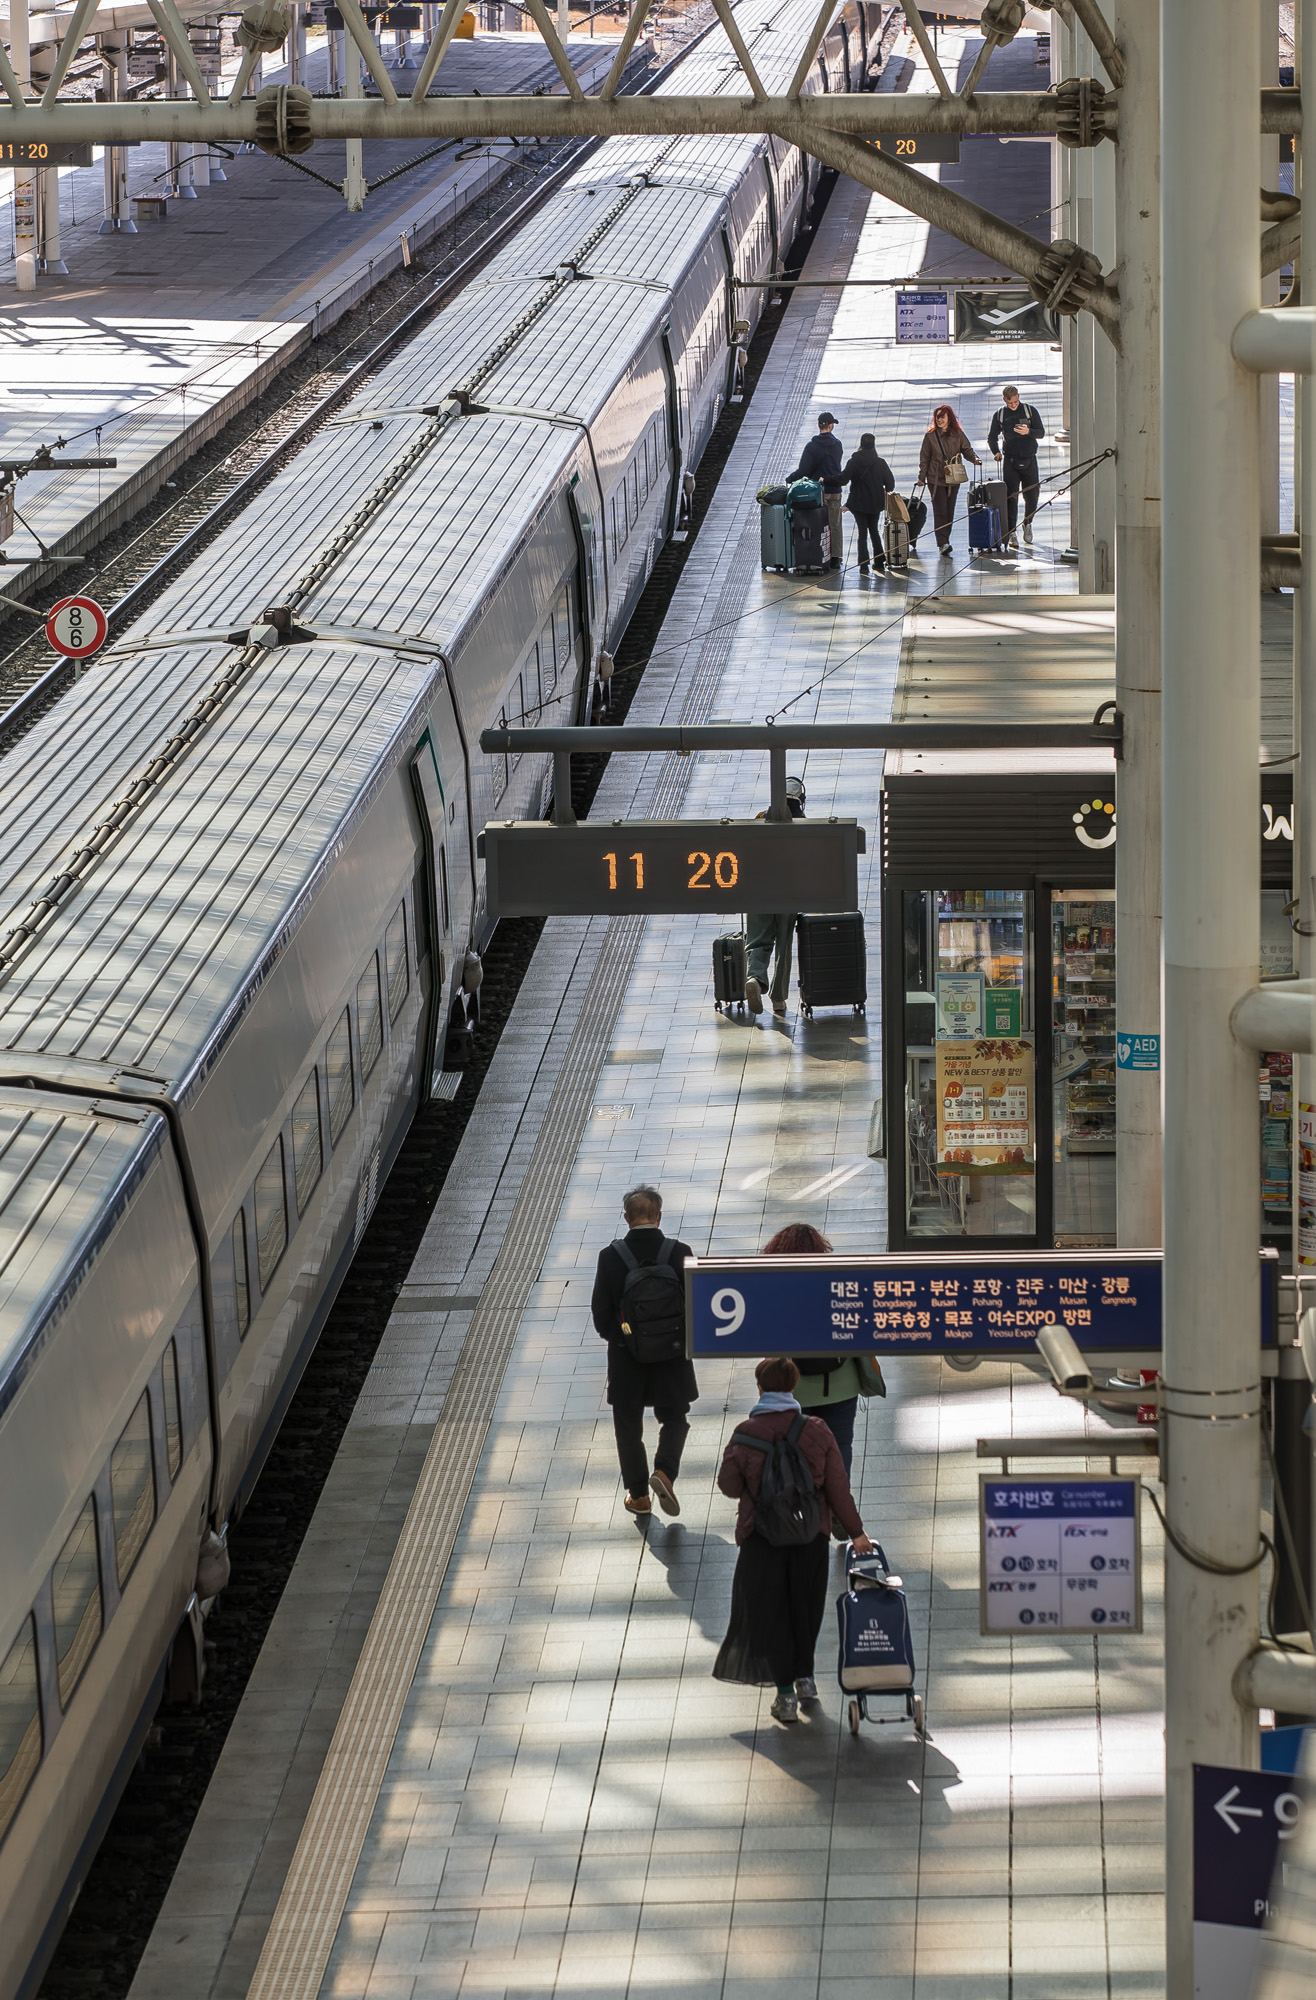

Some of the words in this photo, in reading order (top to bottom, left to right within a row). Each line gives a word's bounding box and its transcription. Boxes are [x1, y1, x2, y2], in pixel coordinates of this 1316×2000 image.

[896, 139, 916, 155] 20
[69, 607, 82, 626] 8
[71, 629, 82, 647] 6
[602, 852, 644, 890] 11
[687, 851, 739, 888] 20
[1133, 1038, 1157, 1051] AED
[992, 1068, 1006, 1077] 상품
[1008, 1068, 1022, 1077] 할인
[831, 1281, 859, 1298] 대전
[873, 1280, 916, 1298] 동대구
[930, 1280, 960, 1297] 부산
[973, 1278, 1003, 1296] 포항
[1016, 1278, 1044, 1295] 진주
[1058, 1277, 1088, 1294] 마산
[1101, 1276, 1130, 1294] 강릉
[831, 1300, 864, 1310] Daejeon
[872, 1299, 917, 1310] Dongdaegu
[930, 1298, 957, 1308] Busan
[972, 1297, 1003, 1308] Pohang
[1017, 1296, 1037, 1308] Jinju
[1059, 1296, 1087, 1305] Masan
[710, 1287, 746, 1337] 9
[831, 1312, 860, 1329] 익산
[873, 1311, 931, 1329] 광주송정
[944, 1310, 973, 1328] 목포
[988, 1310, 1056, 1326] 여수EXPO
[1063, 1309, 1091, 1326] 방면
[832, 1330, 854, 1340] Iksan
[945, 1329, 973, 1340] Mokpo
[988, 1329, 1014, 1338] Yeosu
[1014, 1328, 1036, 1339] Expo
[994, 1490, 1055, 1509] 호차번호
[987, 1524, 1020, 1538] KTX
[1037, 1558, 1058, 1572] 호차
[1108, 1557, 1130, 1571] 호차
[988, 1581, 1016, 1593] KTX
[1037, 1611, 1059, 1625] 호차
[1109, 1610, 1130, 1624] 호차
[1273, 1792, 1304, 1840] 9
